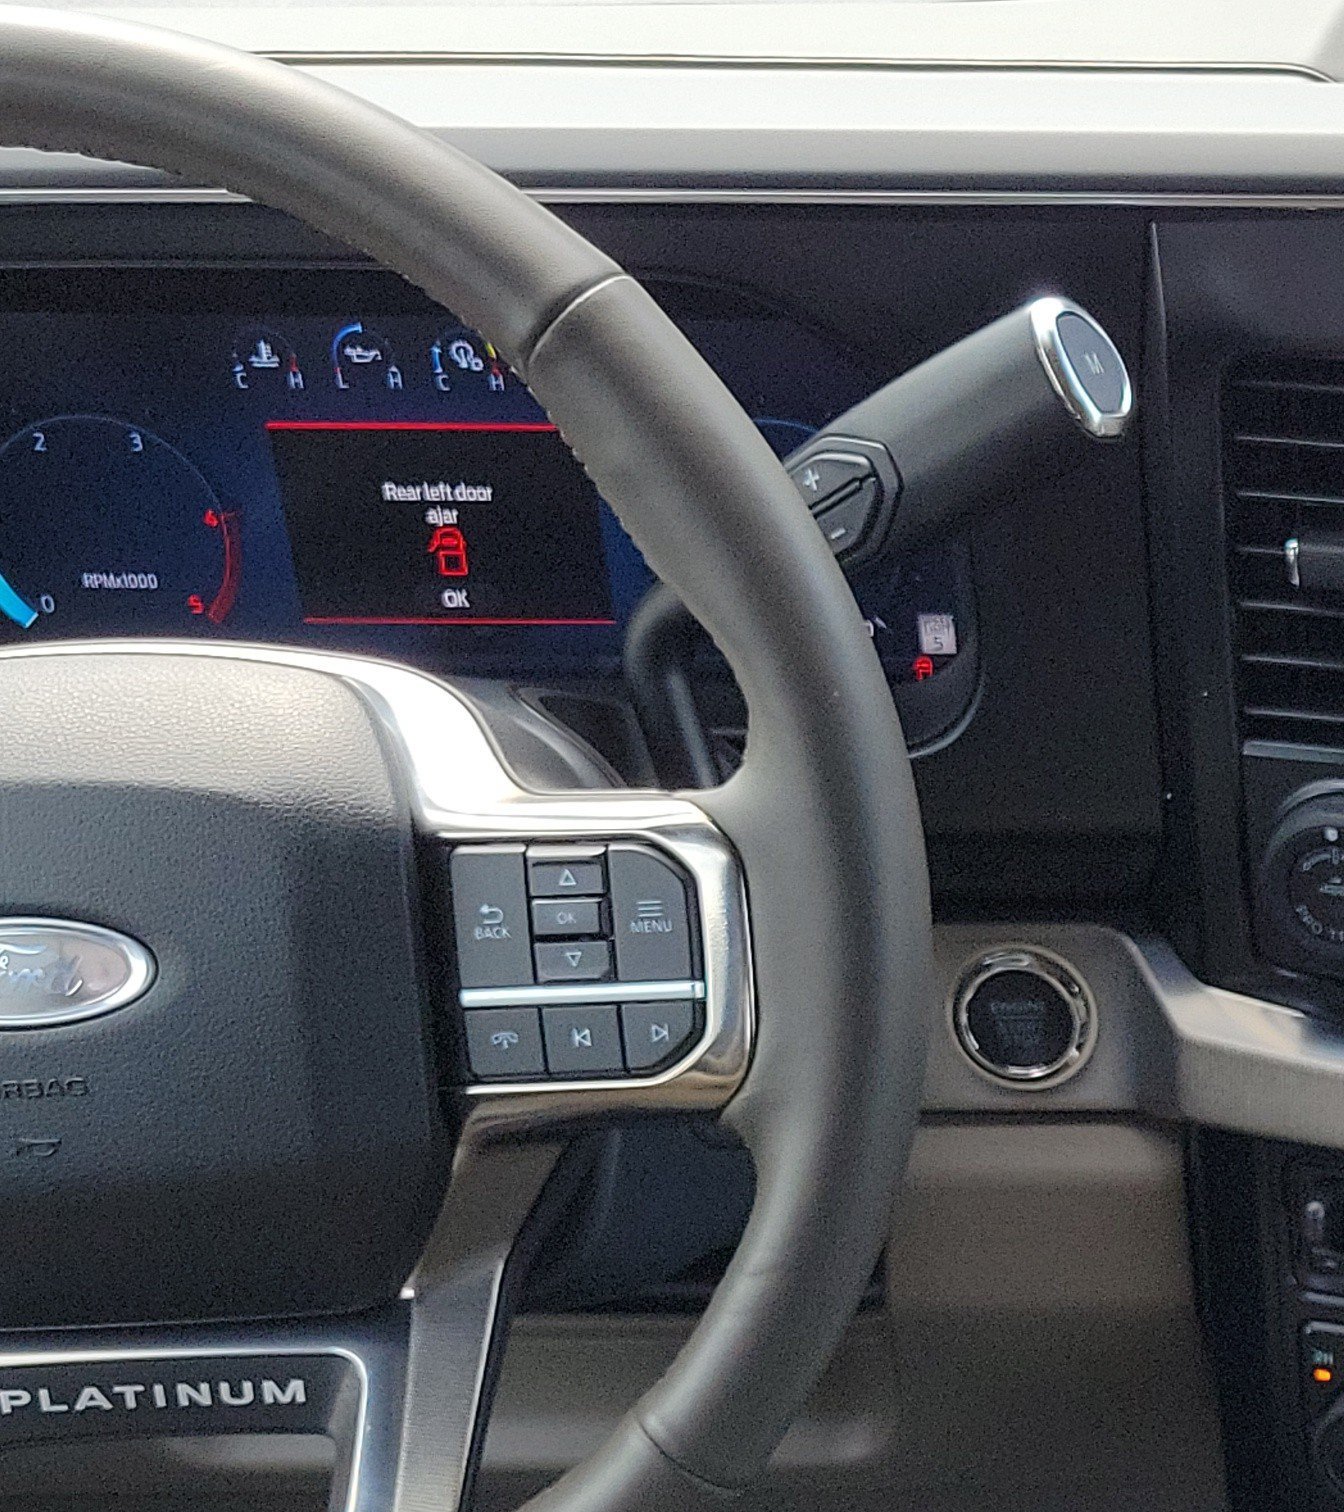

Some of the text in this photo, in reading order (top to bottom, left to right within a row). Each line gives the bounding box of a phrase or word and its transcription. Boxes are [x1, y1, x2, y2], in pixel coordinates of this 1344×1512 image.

[32, 432, 48, 451] 2
[129, 432, 144, 452] 3
[381, 481, 493, 502] Rear left door
[425, 504, 459, 528] ajar
[441, 588, 471, 609] OK
[555, 912, 577, 926] OK
[629, 919, 674, 934] MENU
[473, 926, 512, 941] BACK
[0, 1379, 308, 1414] PLATINUM
